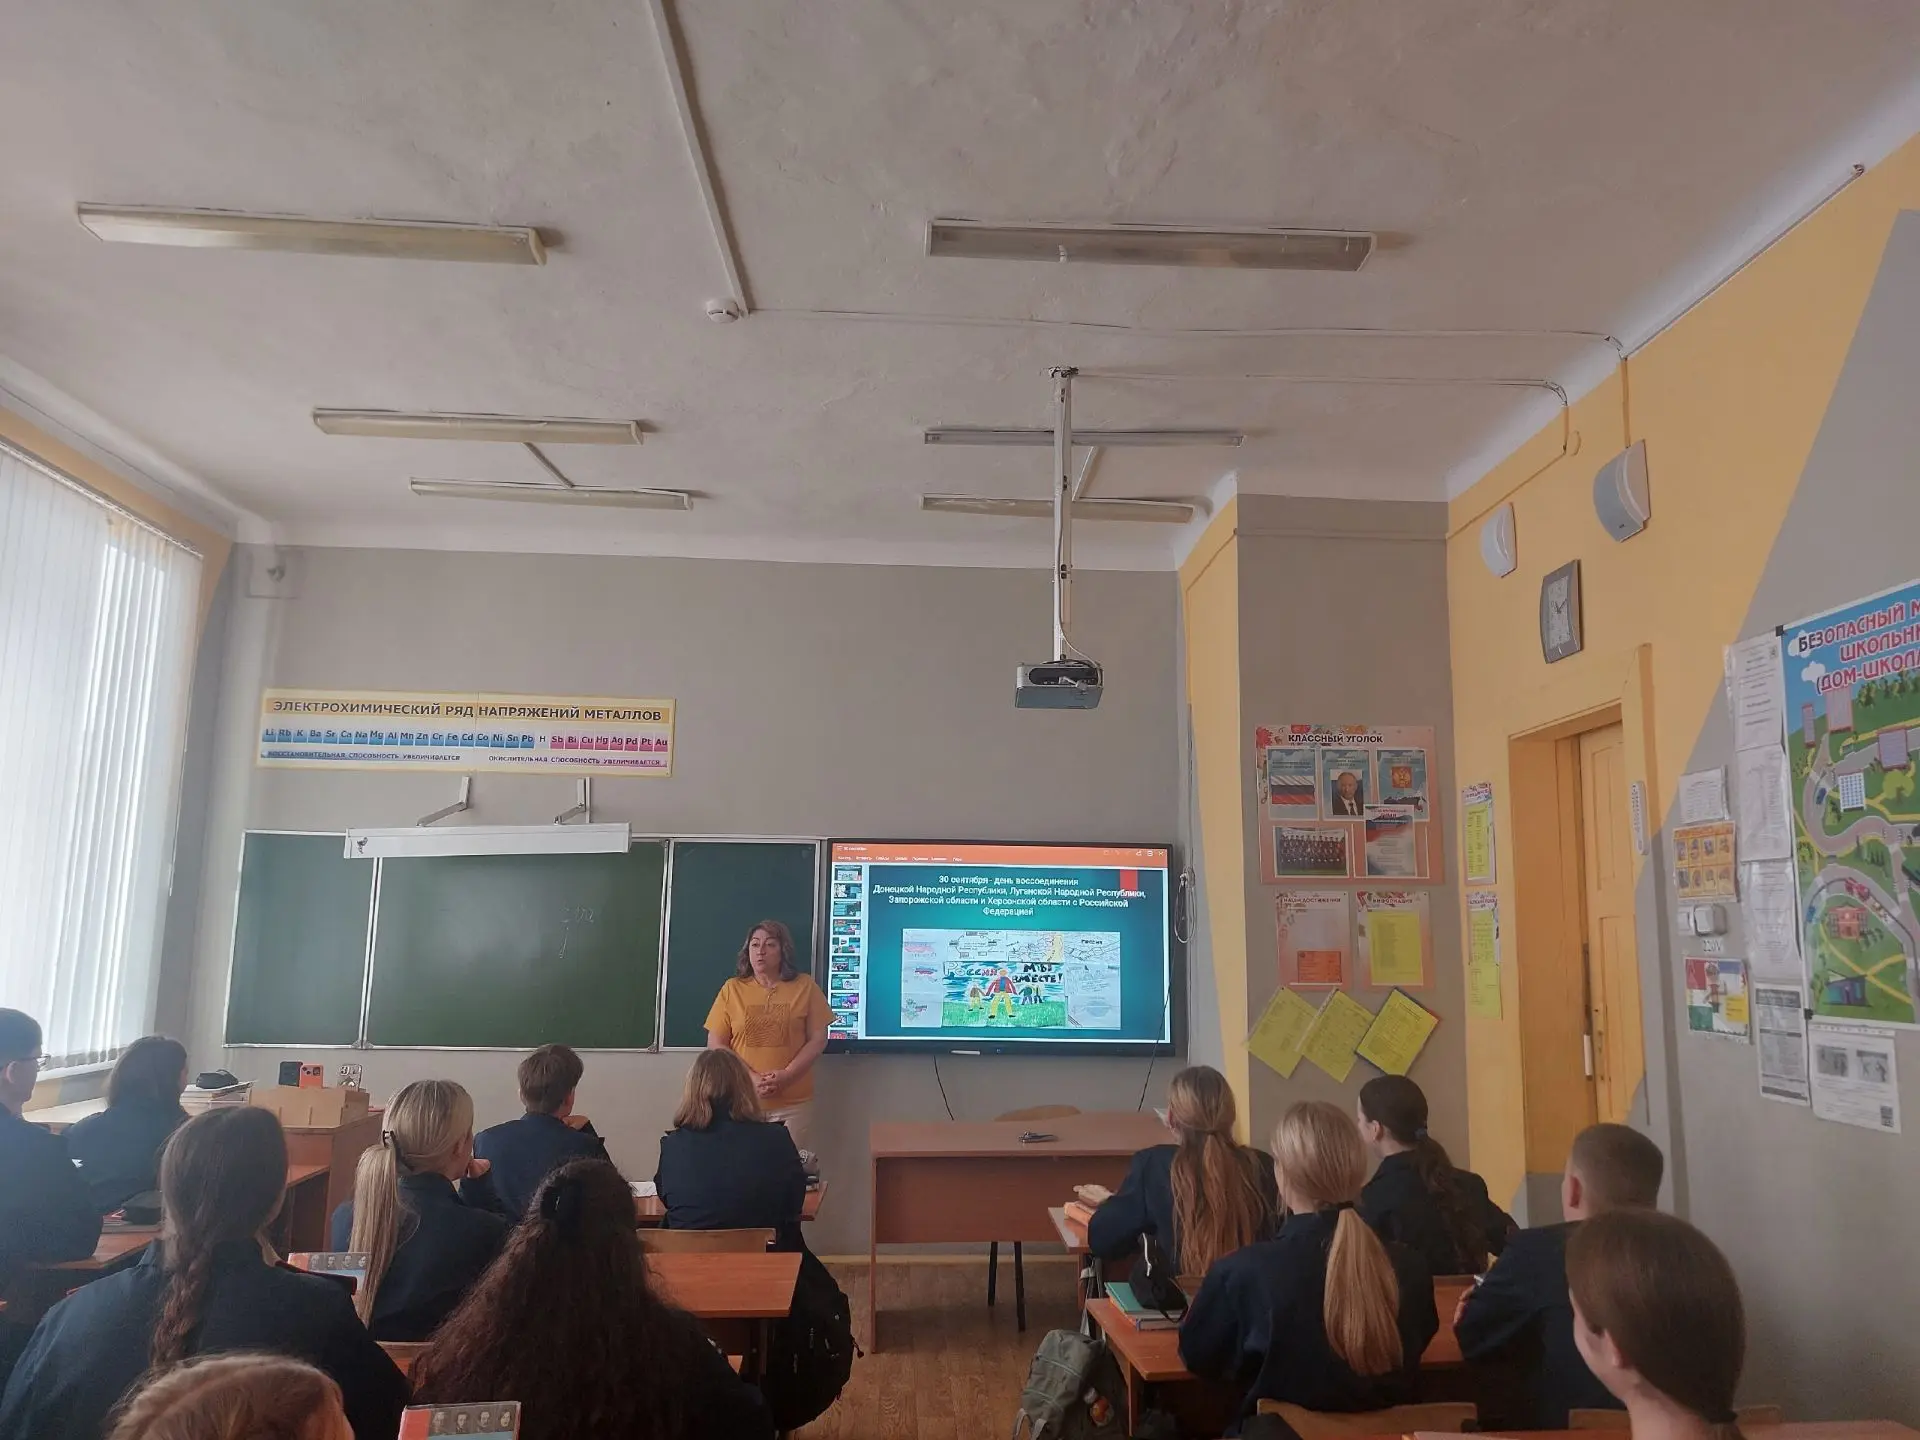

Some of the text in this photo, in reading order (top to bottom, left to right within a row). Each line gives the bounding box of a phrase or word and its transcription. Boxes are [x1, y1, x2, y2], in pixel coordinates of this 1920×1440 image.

[1798, 603, 1904, 653] БЕЗОПАСНЫЙ
[273, 700, 662, 721] ЭЛЕКТРОХИМИЧЕСКИЙ РЯД НАПРЯЖЕНИЙ МЕТАЛЛОВ
[370, 731, 384, 740] Mg
[462, 732, 474, 742] Cd
[477, 733, 488, 741] Co
[596, 736, 608, 744] Hg
[611, 737, 623, 746] Ag
[1288, 733, 1343, 742] КЛАССНЫЙ
[951, 876, 988, 886] сентября
[994, 876, 1013, 885] день
[873, 885, 1007, 895] Донецкой Народной Республики,
[1009, 887, 1146, 899] Луганской Народной Республики,
[889, 896, 944, 905] Запорожской
[988, 897, 1036, 906] Херсонской
[1079, 899, 1129, 908] Российской
[982, 907, 1034, 917] Федерацией
